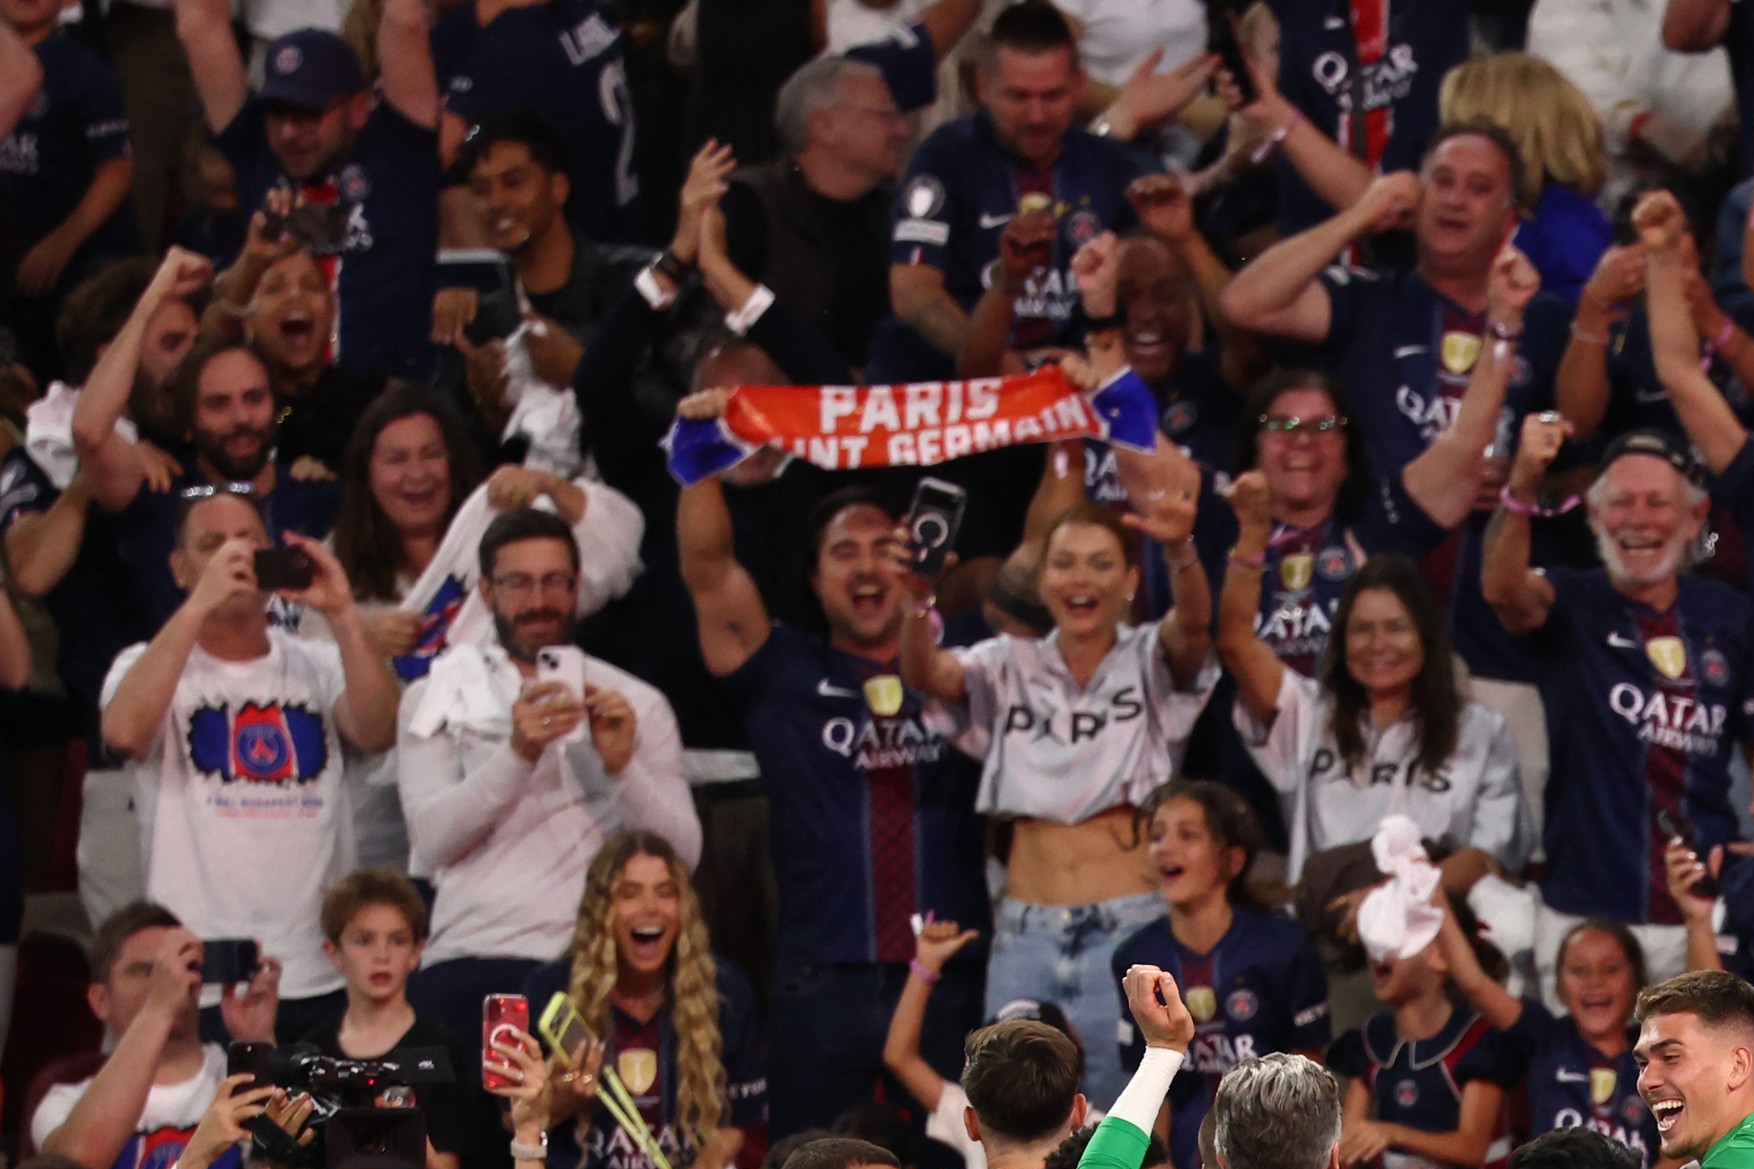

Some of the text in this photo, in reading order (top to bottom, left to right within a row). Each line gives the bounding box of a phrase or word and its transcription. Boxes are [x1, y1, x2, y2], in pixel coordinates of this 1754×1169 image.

[820, 377, 1003, 434] PARIS
[888, 392, 1090, 468] GERMAIN
[1609, 681, 1728, 735] QATAR
